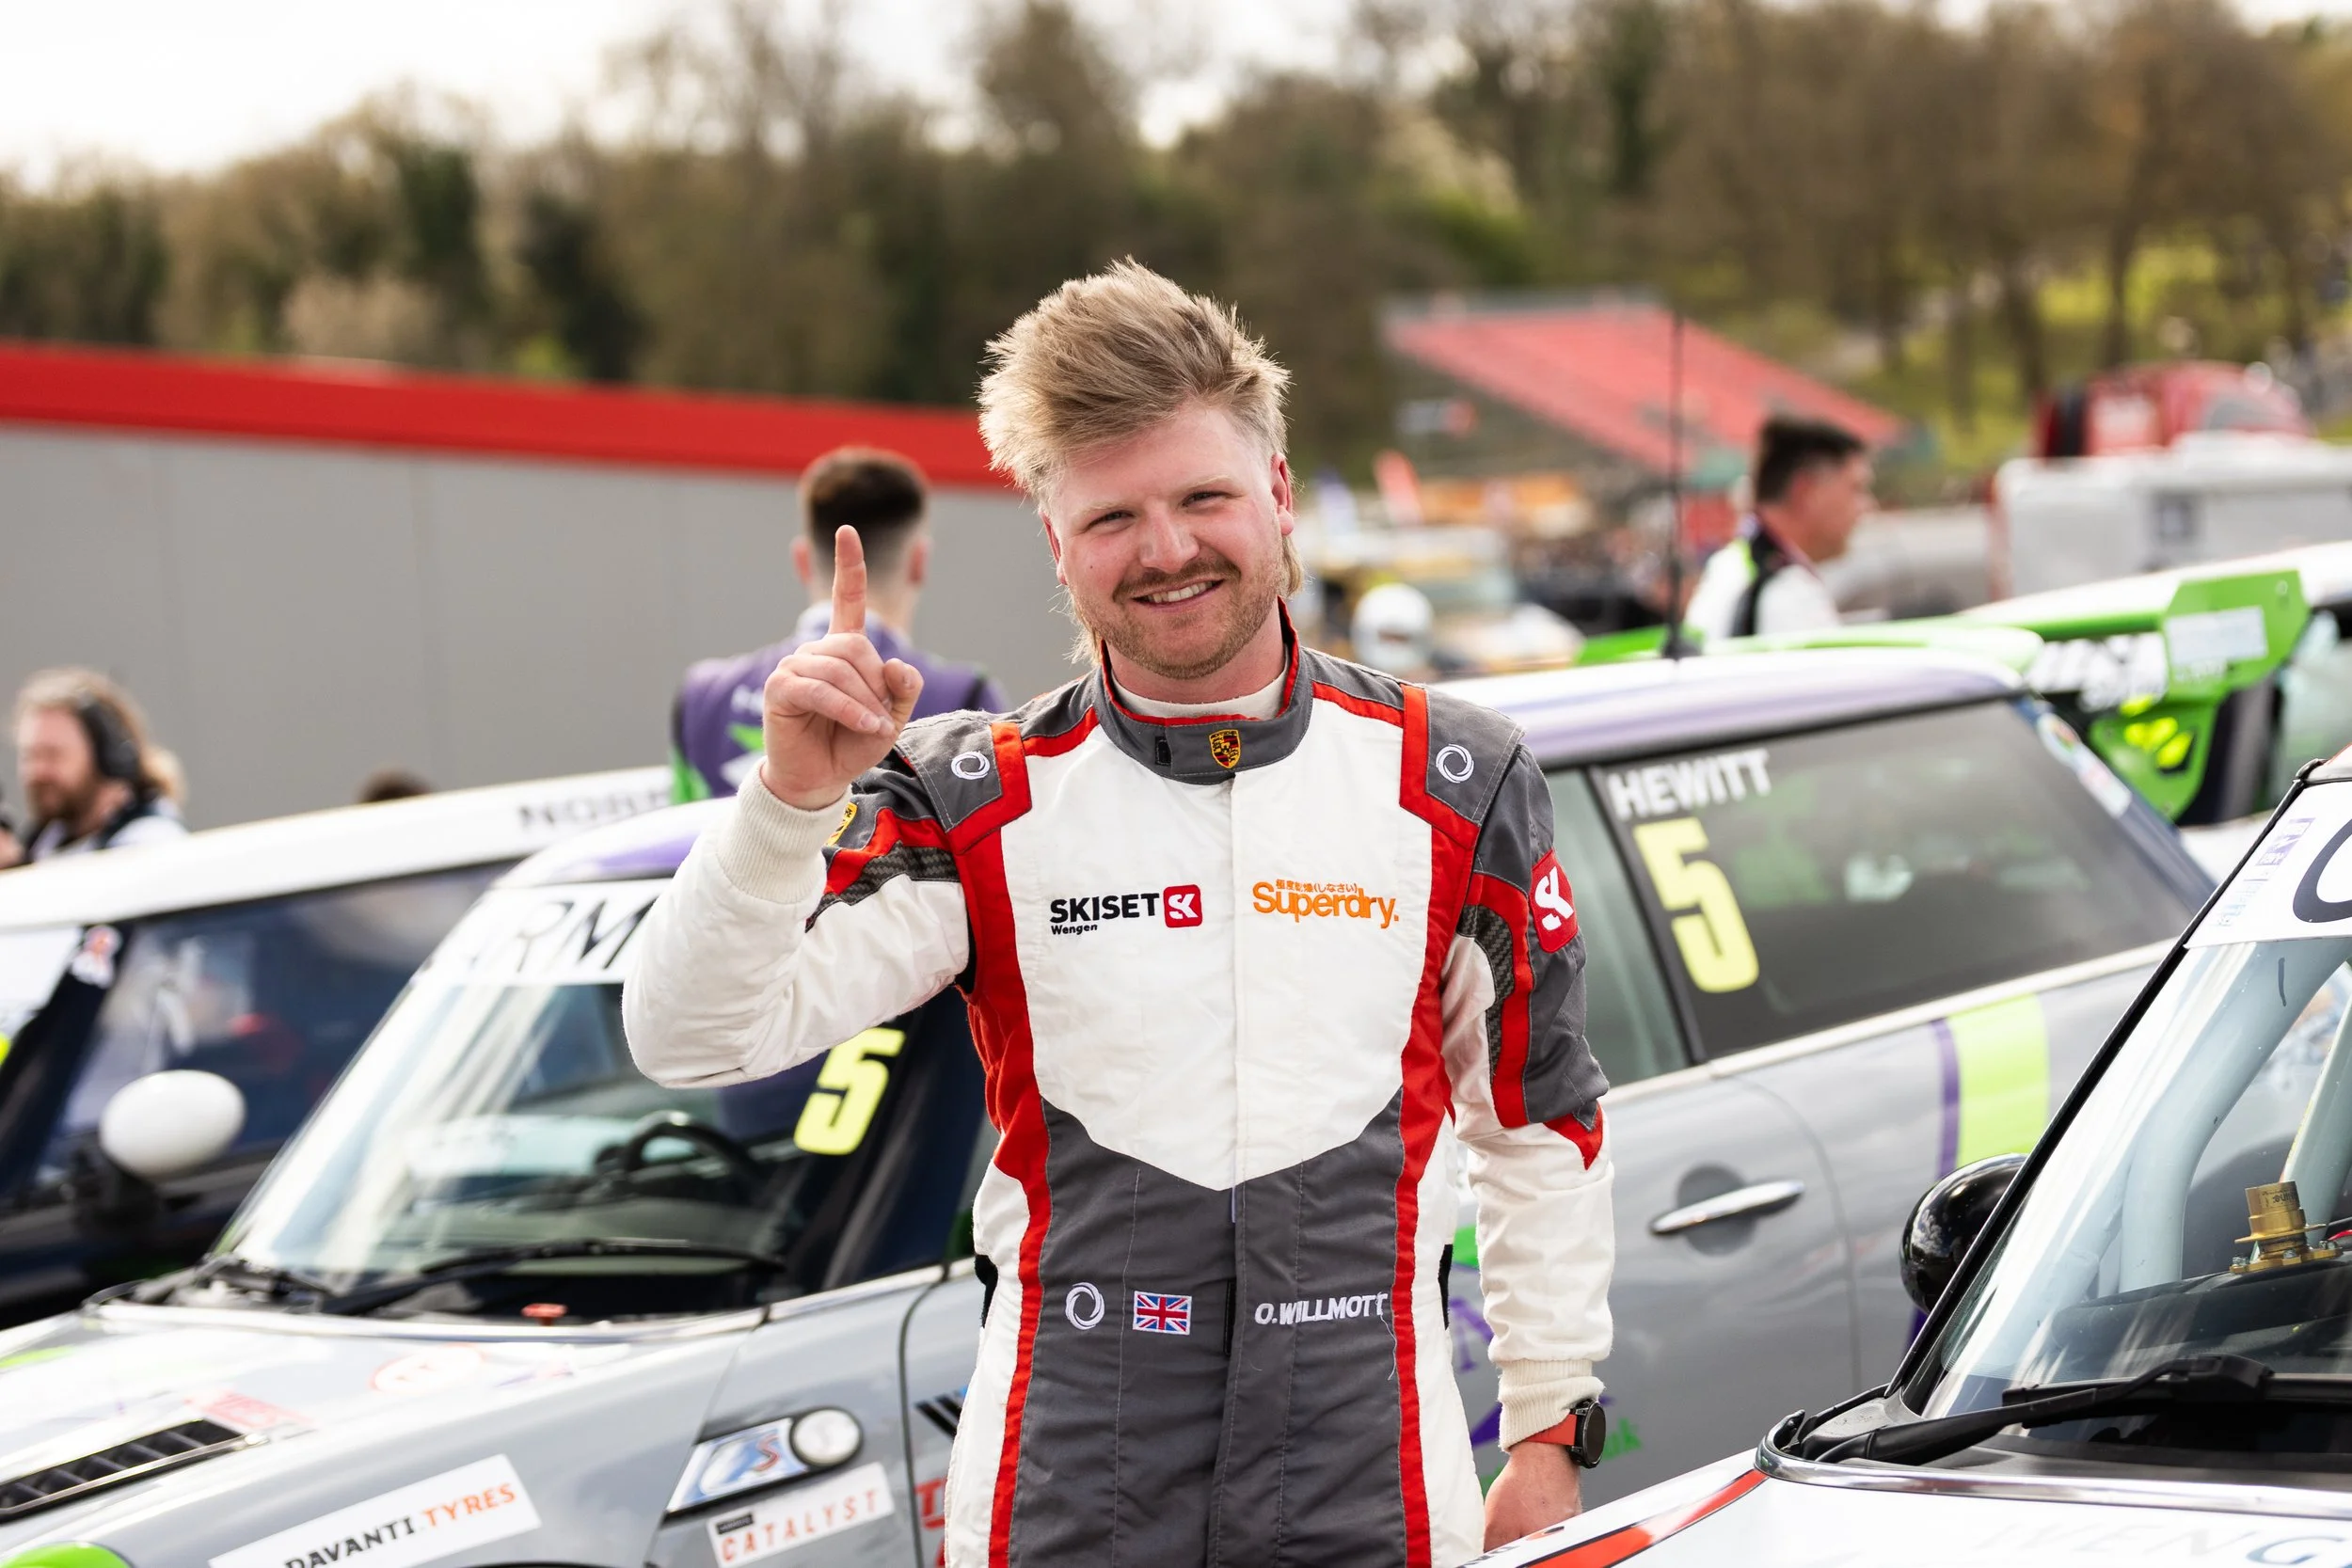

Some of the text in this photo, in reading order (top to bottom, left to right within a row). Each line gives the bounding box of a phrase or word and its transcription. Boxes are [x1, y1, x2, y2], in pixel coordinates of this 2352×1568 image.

[1607, 748, 1772, 821] HEWITT
[1049, 893, 1160, 924] SKISET
[1051, 924, 1098, 935] Wengen
[1632, 816, 1761, 994] 5
[793, 1026, 906, 1156] 5
[1254, 1292, 1389, 1325] O.WILLMOTT
[422, 1483, 516, 1528] TYRES
[721, 1489, 881, 1562] CATALYST
